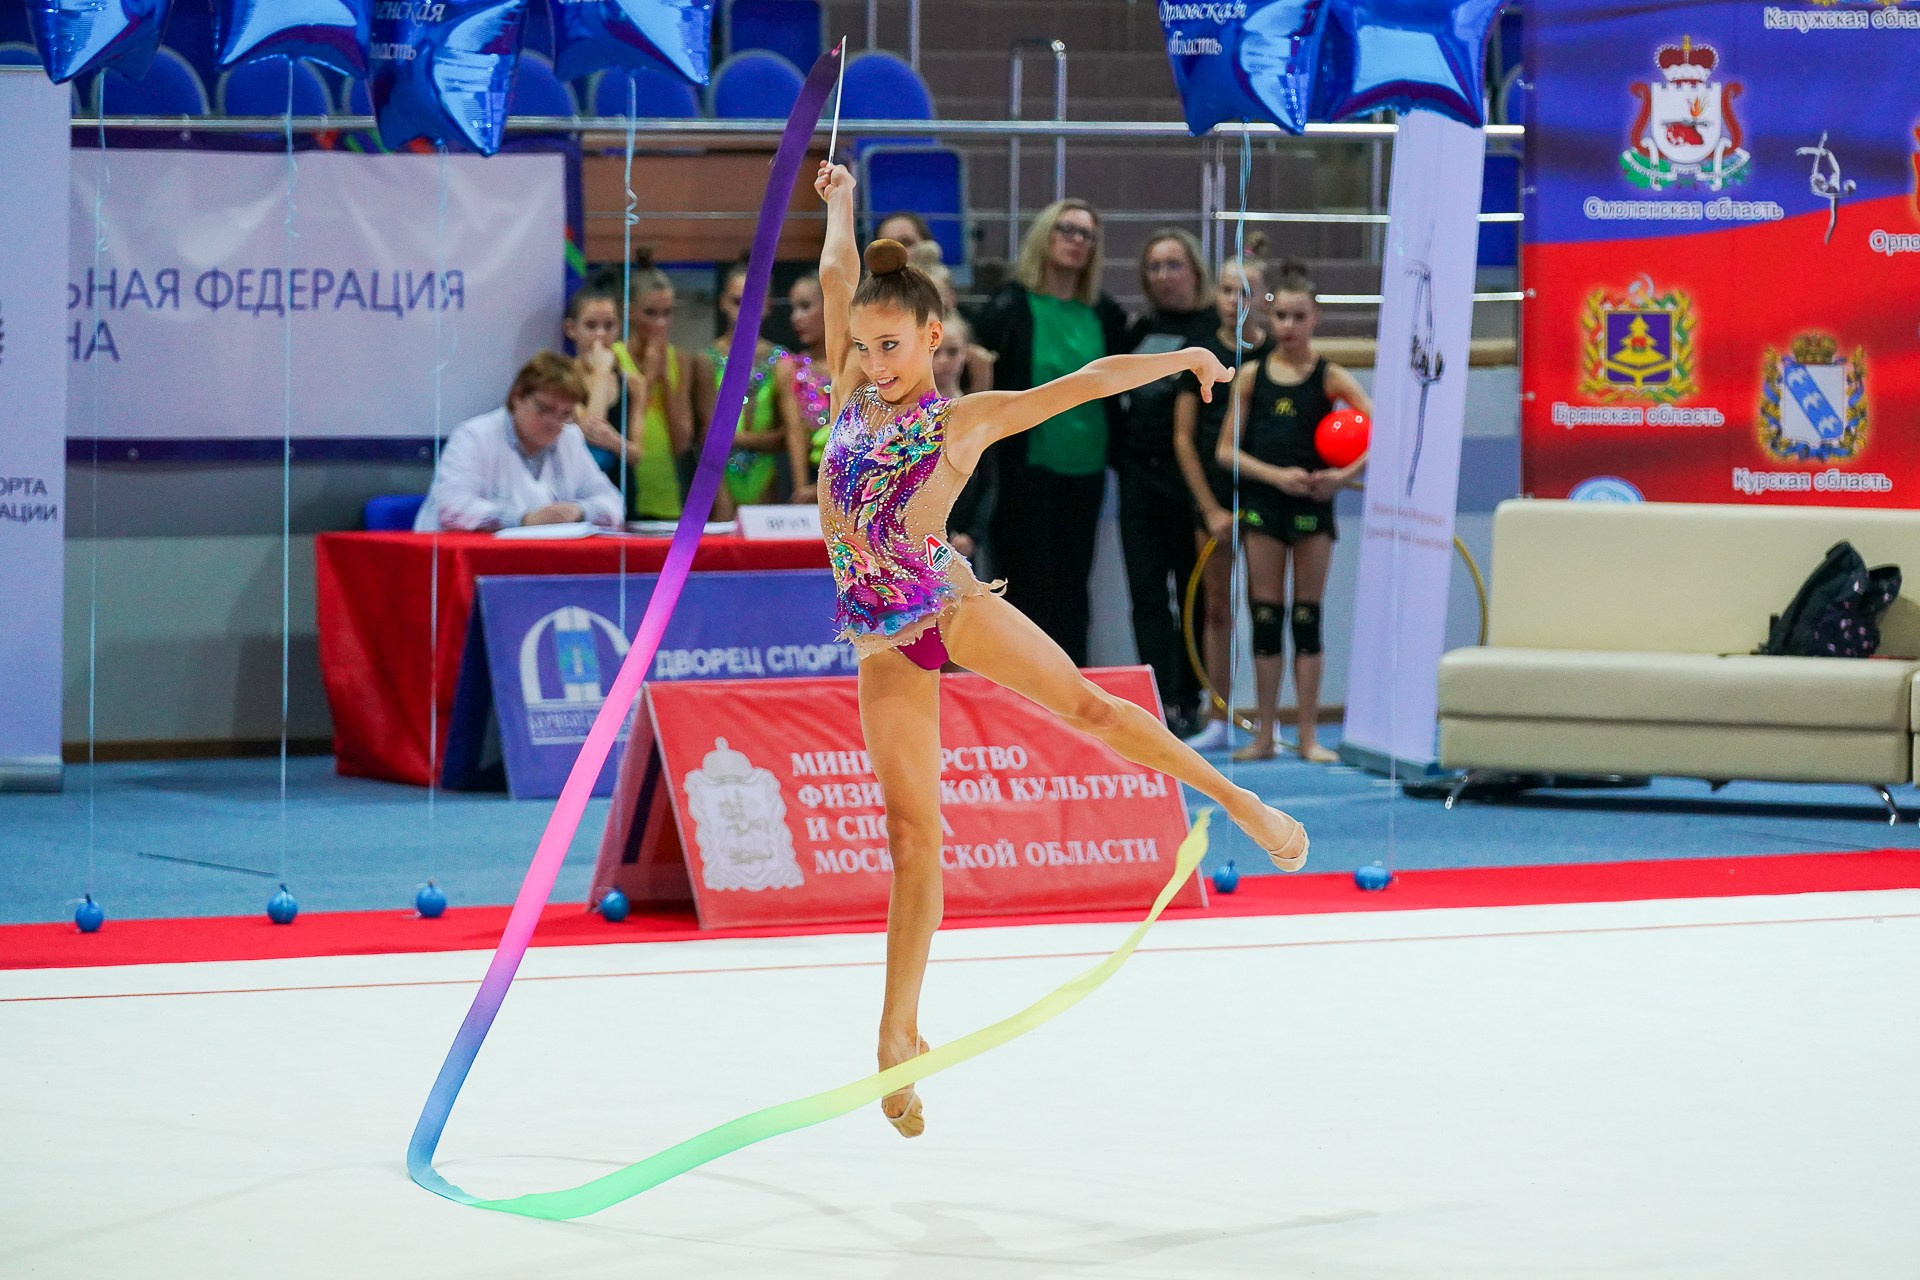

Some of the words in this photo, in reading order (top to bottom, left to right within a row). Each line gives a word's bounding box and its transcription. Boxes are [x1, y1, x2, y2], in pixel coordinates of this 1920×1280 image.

[1764, 6, 1868, 33] Калужская
[1584, 197, 1702, 220] Смоленская
[1704, 197, 1783, 220] область
[194, 266, 466, 318] ФЕДЕРАЦИЯ
[1552, 402, 1642, 429] Брянская
[1646, 403, 1724, 427] область
[1733, 468, 1811, 493] Курская
[1814, 469, 1892, 492] область
[655, 647, 765, 680] ДВОРЕЦ
[798, 773, 1003, 809] ФИЗИКОЙ
[1009, 773, 1168, 801] КУЛЬТУРЫ
[805, 817, 831, 842] И
[814, 838, 1018, 875] МОСКСКОЙ
[1024, 837, 1160, 867] ОБЛАСТИ
